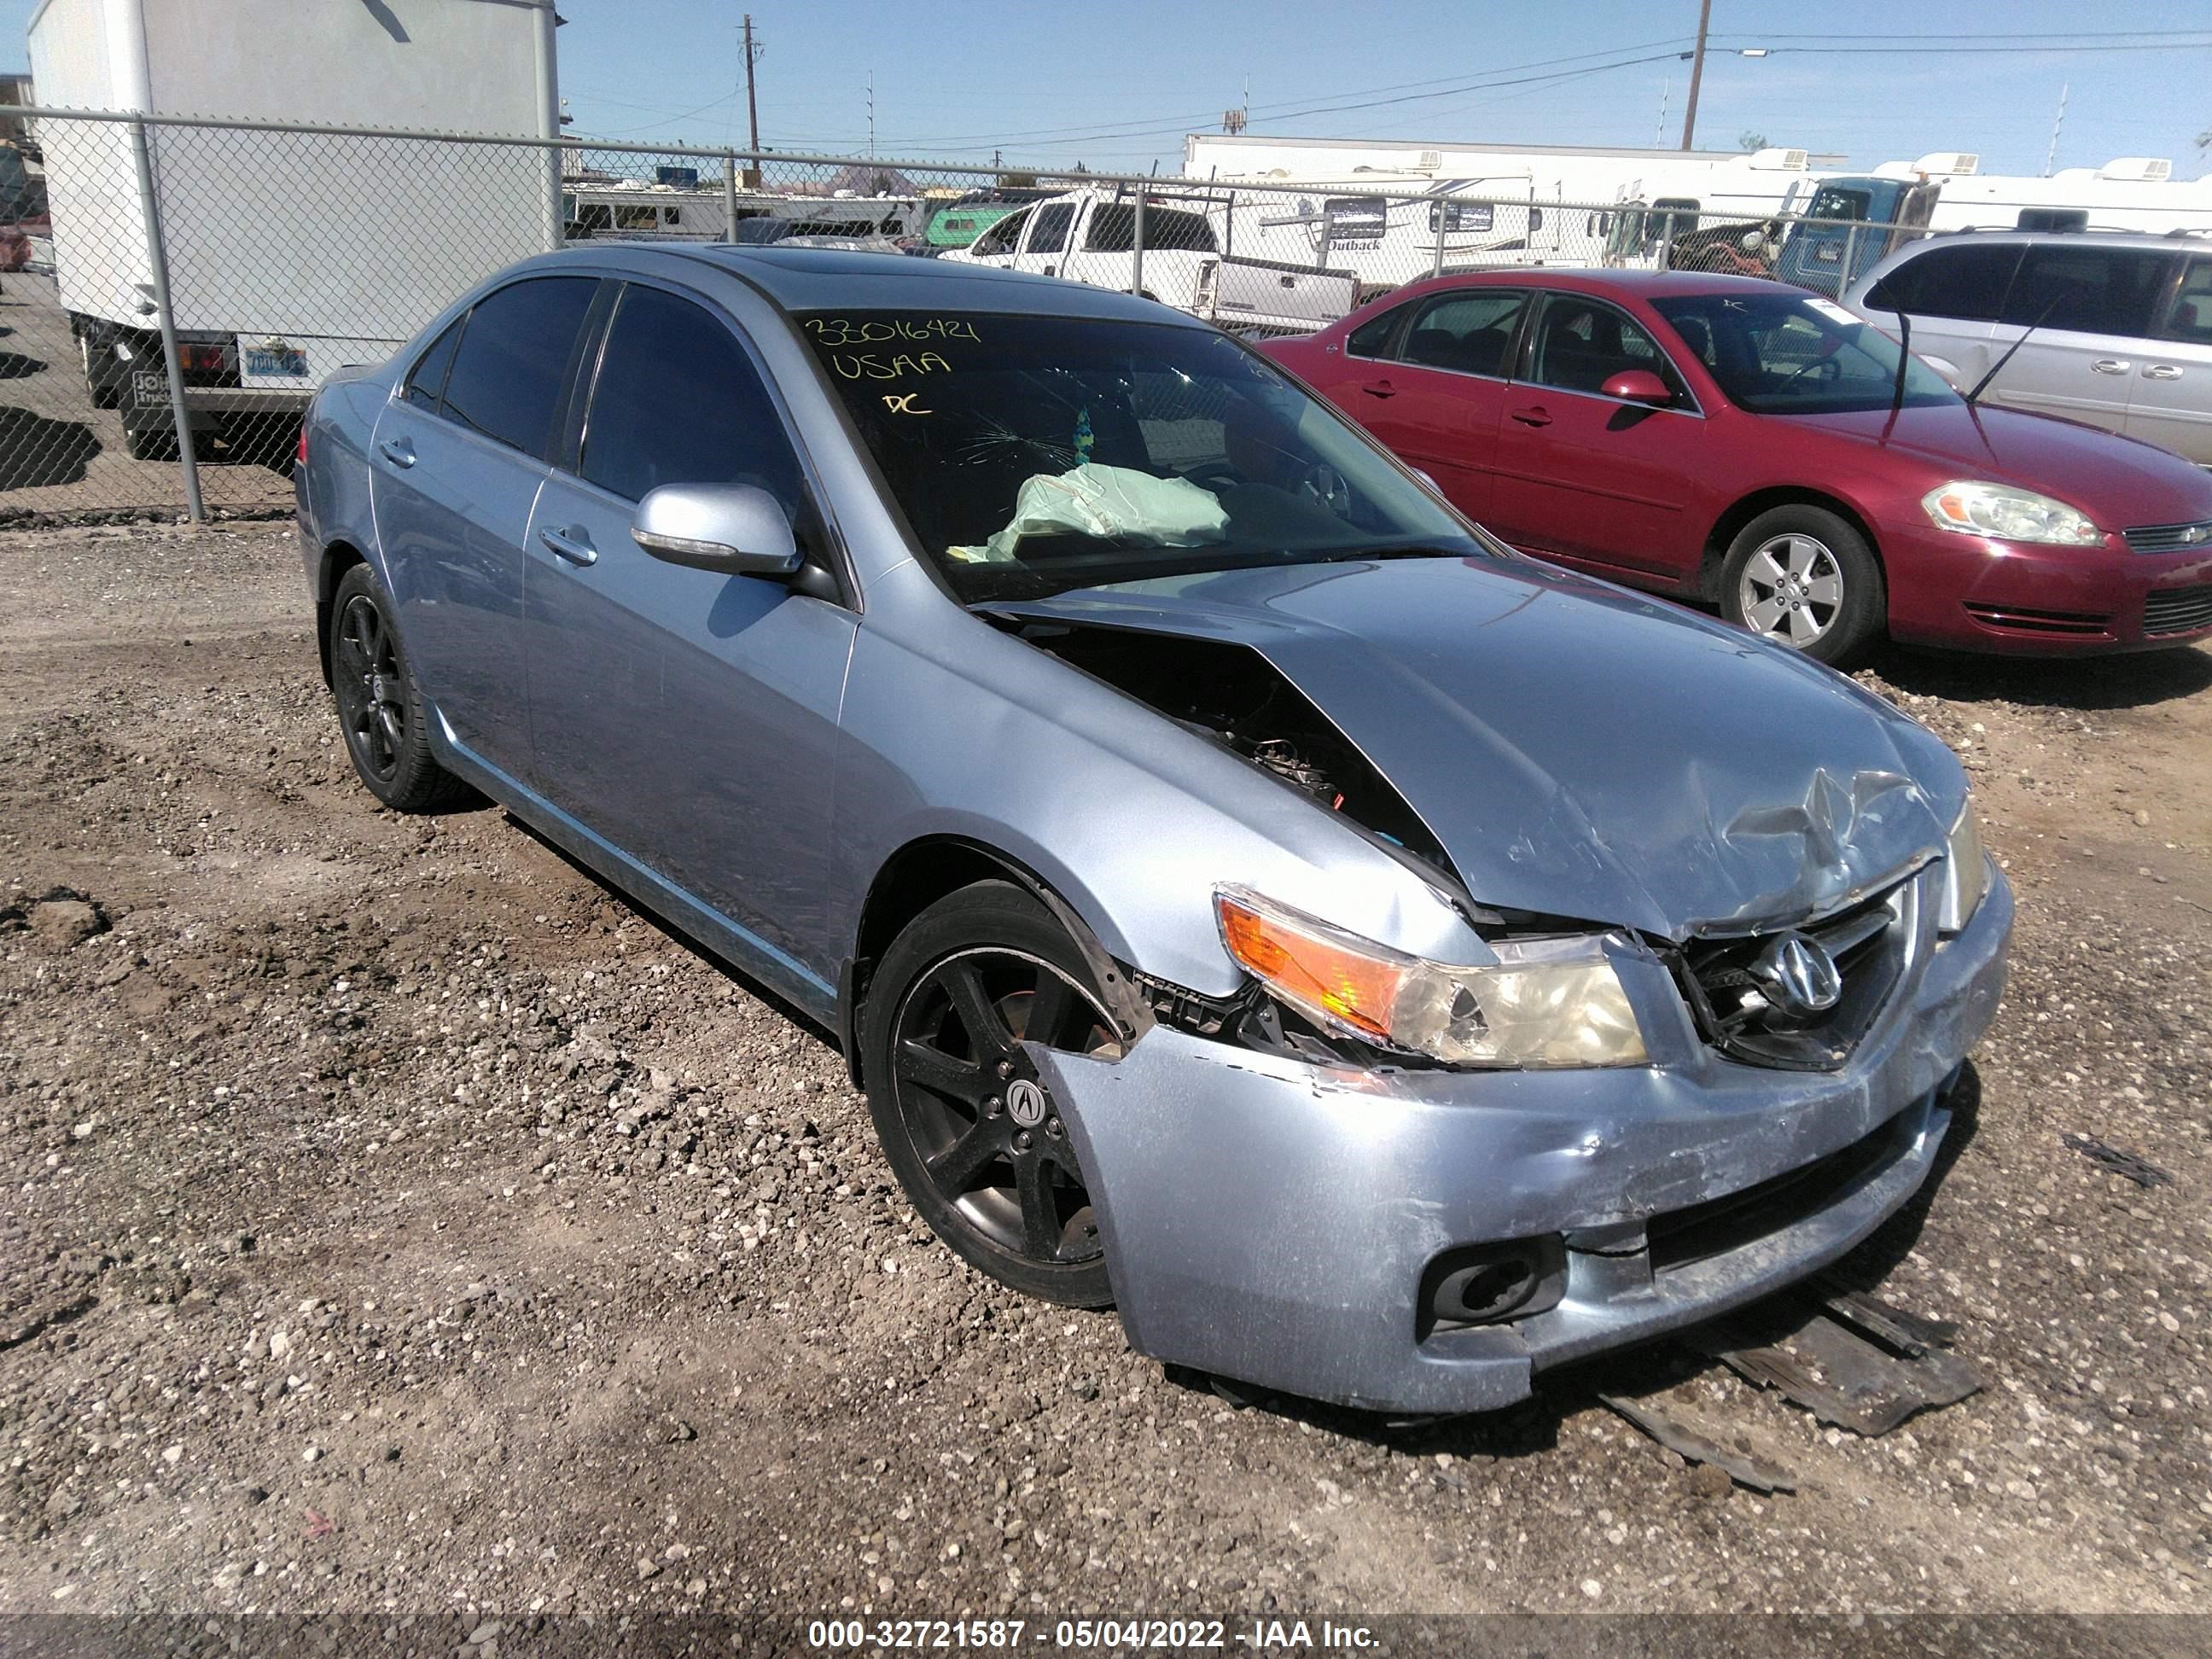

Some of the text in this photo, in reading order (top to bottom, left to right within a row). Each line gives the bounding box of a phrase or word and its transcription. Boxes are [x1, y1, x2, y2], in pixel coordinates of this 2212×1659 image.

[1328, 239, 1381, 252] Outback
[806, 319, 981, 346] 33016421
[833, 352, 952, 379] USAA
[882, 393, 934, 415] DC
